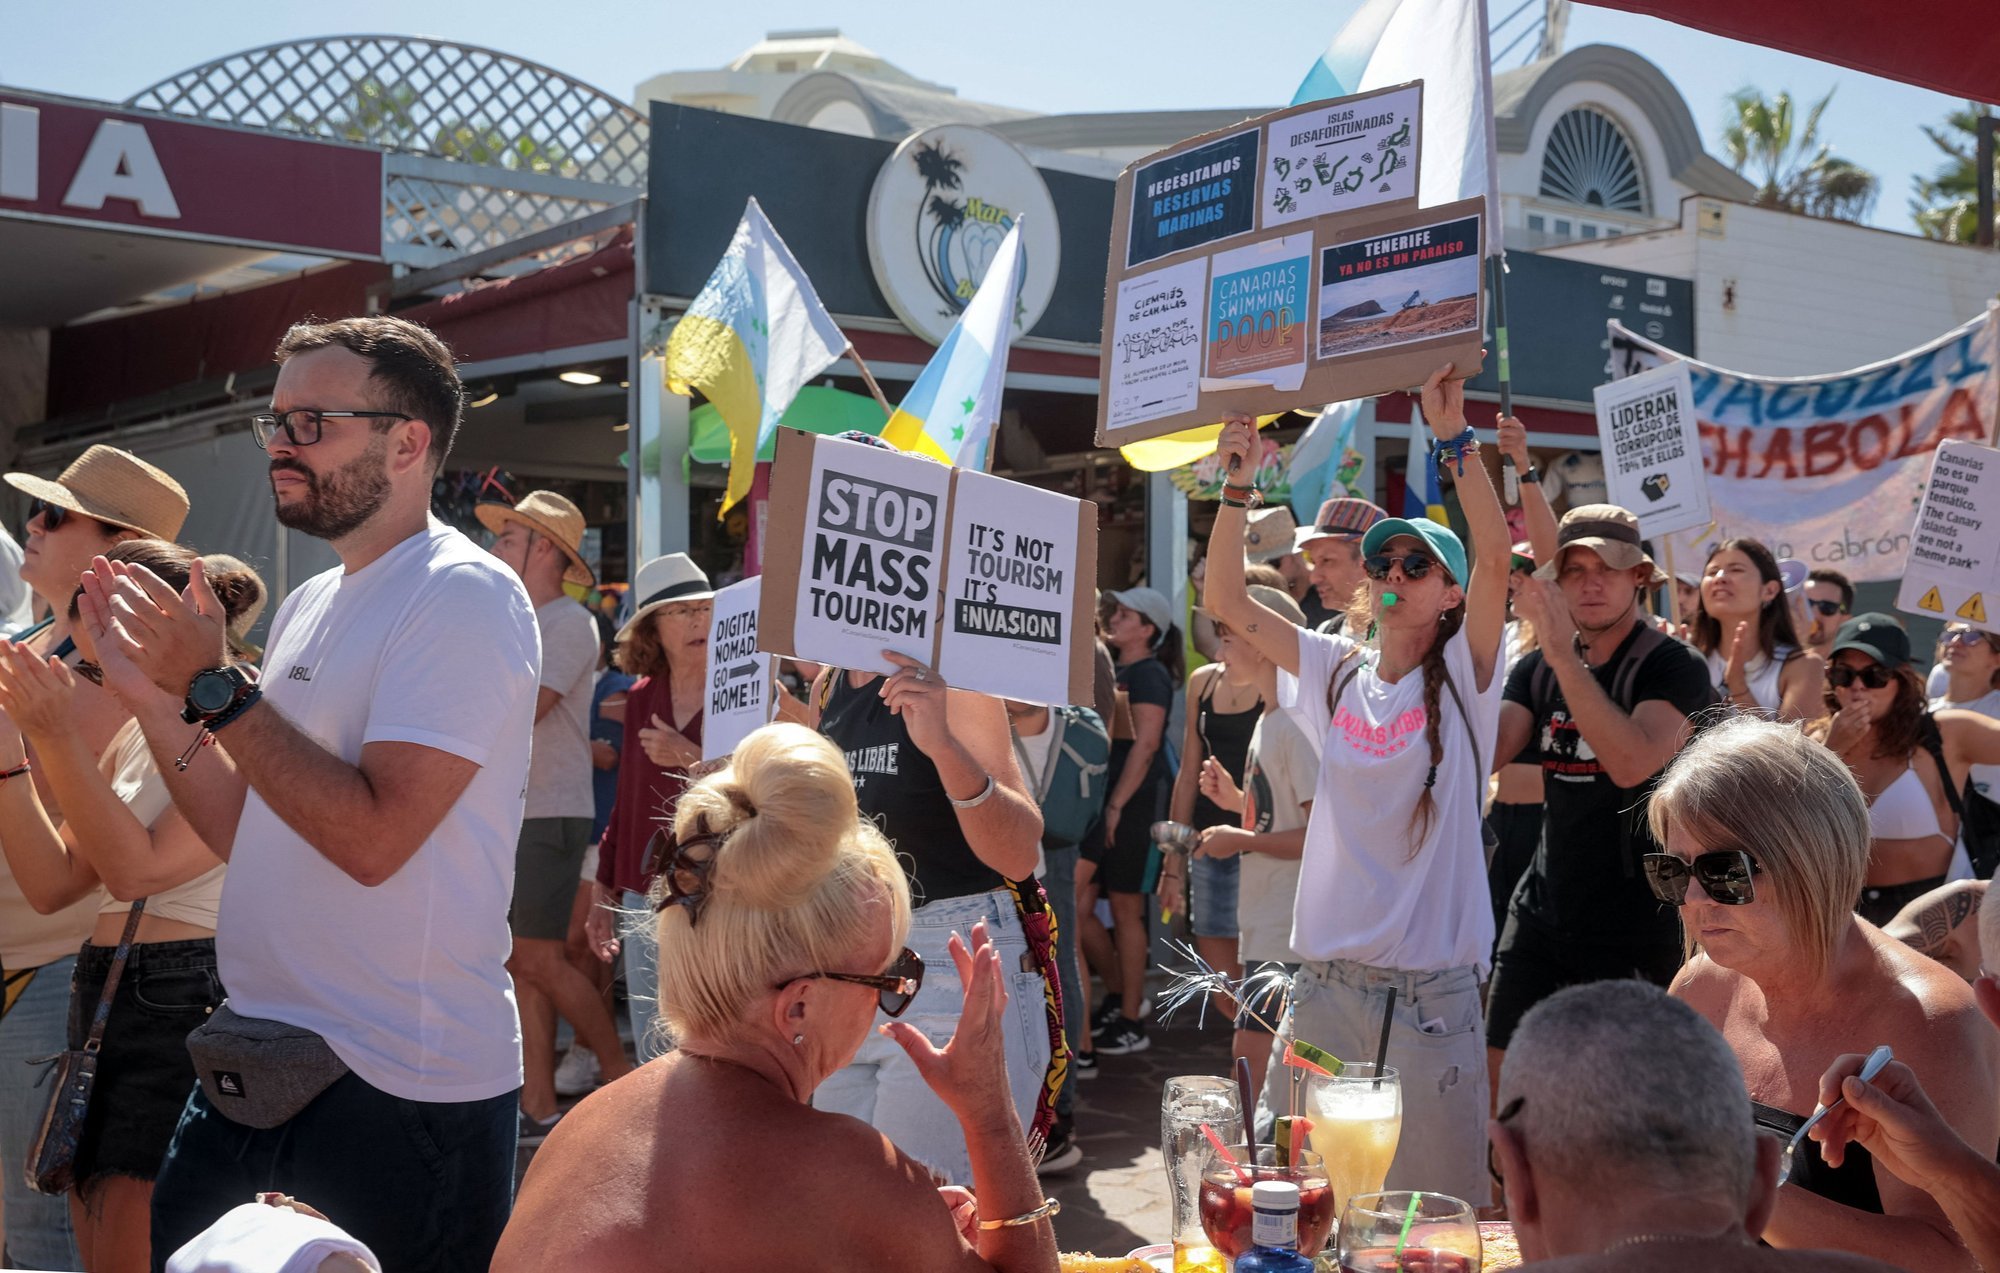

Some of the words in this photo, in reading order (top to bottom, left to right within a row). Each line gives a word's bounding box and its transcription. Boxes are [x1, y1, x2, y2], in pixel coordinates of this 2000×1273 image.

[1290, 111, 1395, 148] DESAFORTUNADAS
[1327, 109, 1355, 125] ISLAS
[1147, 155, 1241, 198] NECESITAMOS
[1152, 178, 1232, 218] RESERVAS
[1157, 203, 1224, 238] MARINAS
[1339, 263, 1355, 276] YA
[1356, 260, 1373, 273] NO
[1376, 257, 1390, 269] ES
[1392, 252, 1410, 266] UN
[1412, 240, 1464, 263] PARAÍSO
[1364, 231, 1431, 257] TENERIFE
[1220, 265, 1296, 299] CANARIAS
[1129, 312, 1141, 322] DE
[1219, 286, 1295, 319] SWIMMING
[1610, 392, 1678, 430] LIDERAN
[1613, 427, 1631, 442] LOS
[1633, 417, 1664, 436] CASOS
[1666, 411, 1680, 426] DE
[1642, 455, 1655, 468] DE
[1657, 445, 1685, 464] ELLOS
[1939, 450, 1984, 471] Canarias
[1931, 478, 1969, 496] parque
[1935, 465, 1949, 476] no
[1951, 469, 1964, 480] es
[1965, 472, 1979, 484] un
[821, 478, 934, 542] STOP
[1929, 490, 1977, 512] temático.
[1921, 519, 1958, 537] Islands
[1925, 505, 1944, 520] The
[1946, 511, 1983, 531] Canary
[1015, 534, 1054, 564] NOT
[1811, 528, 1910, 562] cabrón
[1914, 547, 1948, 563] theme
[1918, 533, 1934, 545] are
[1936, 537, 1954, 551] not
[1955, 543, 1963, 553] a
[811, 534, 931, 601] MASS
[968, 549, 1063, 595] TOURISM
[716, 610, 756, 642] DIGITA
[810, 587, 927, 639] TOURISM
[715, 636, 760, 665] NOMAD
[713, 667, 728, 689] GO
[1390, 704, 1428, 740] LIBR
[857, 743, 900, 775] LIBRE
